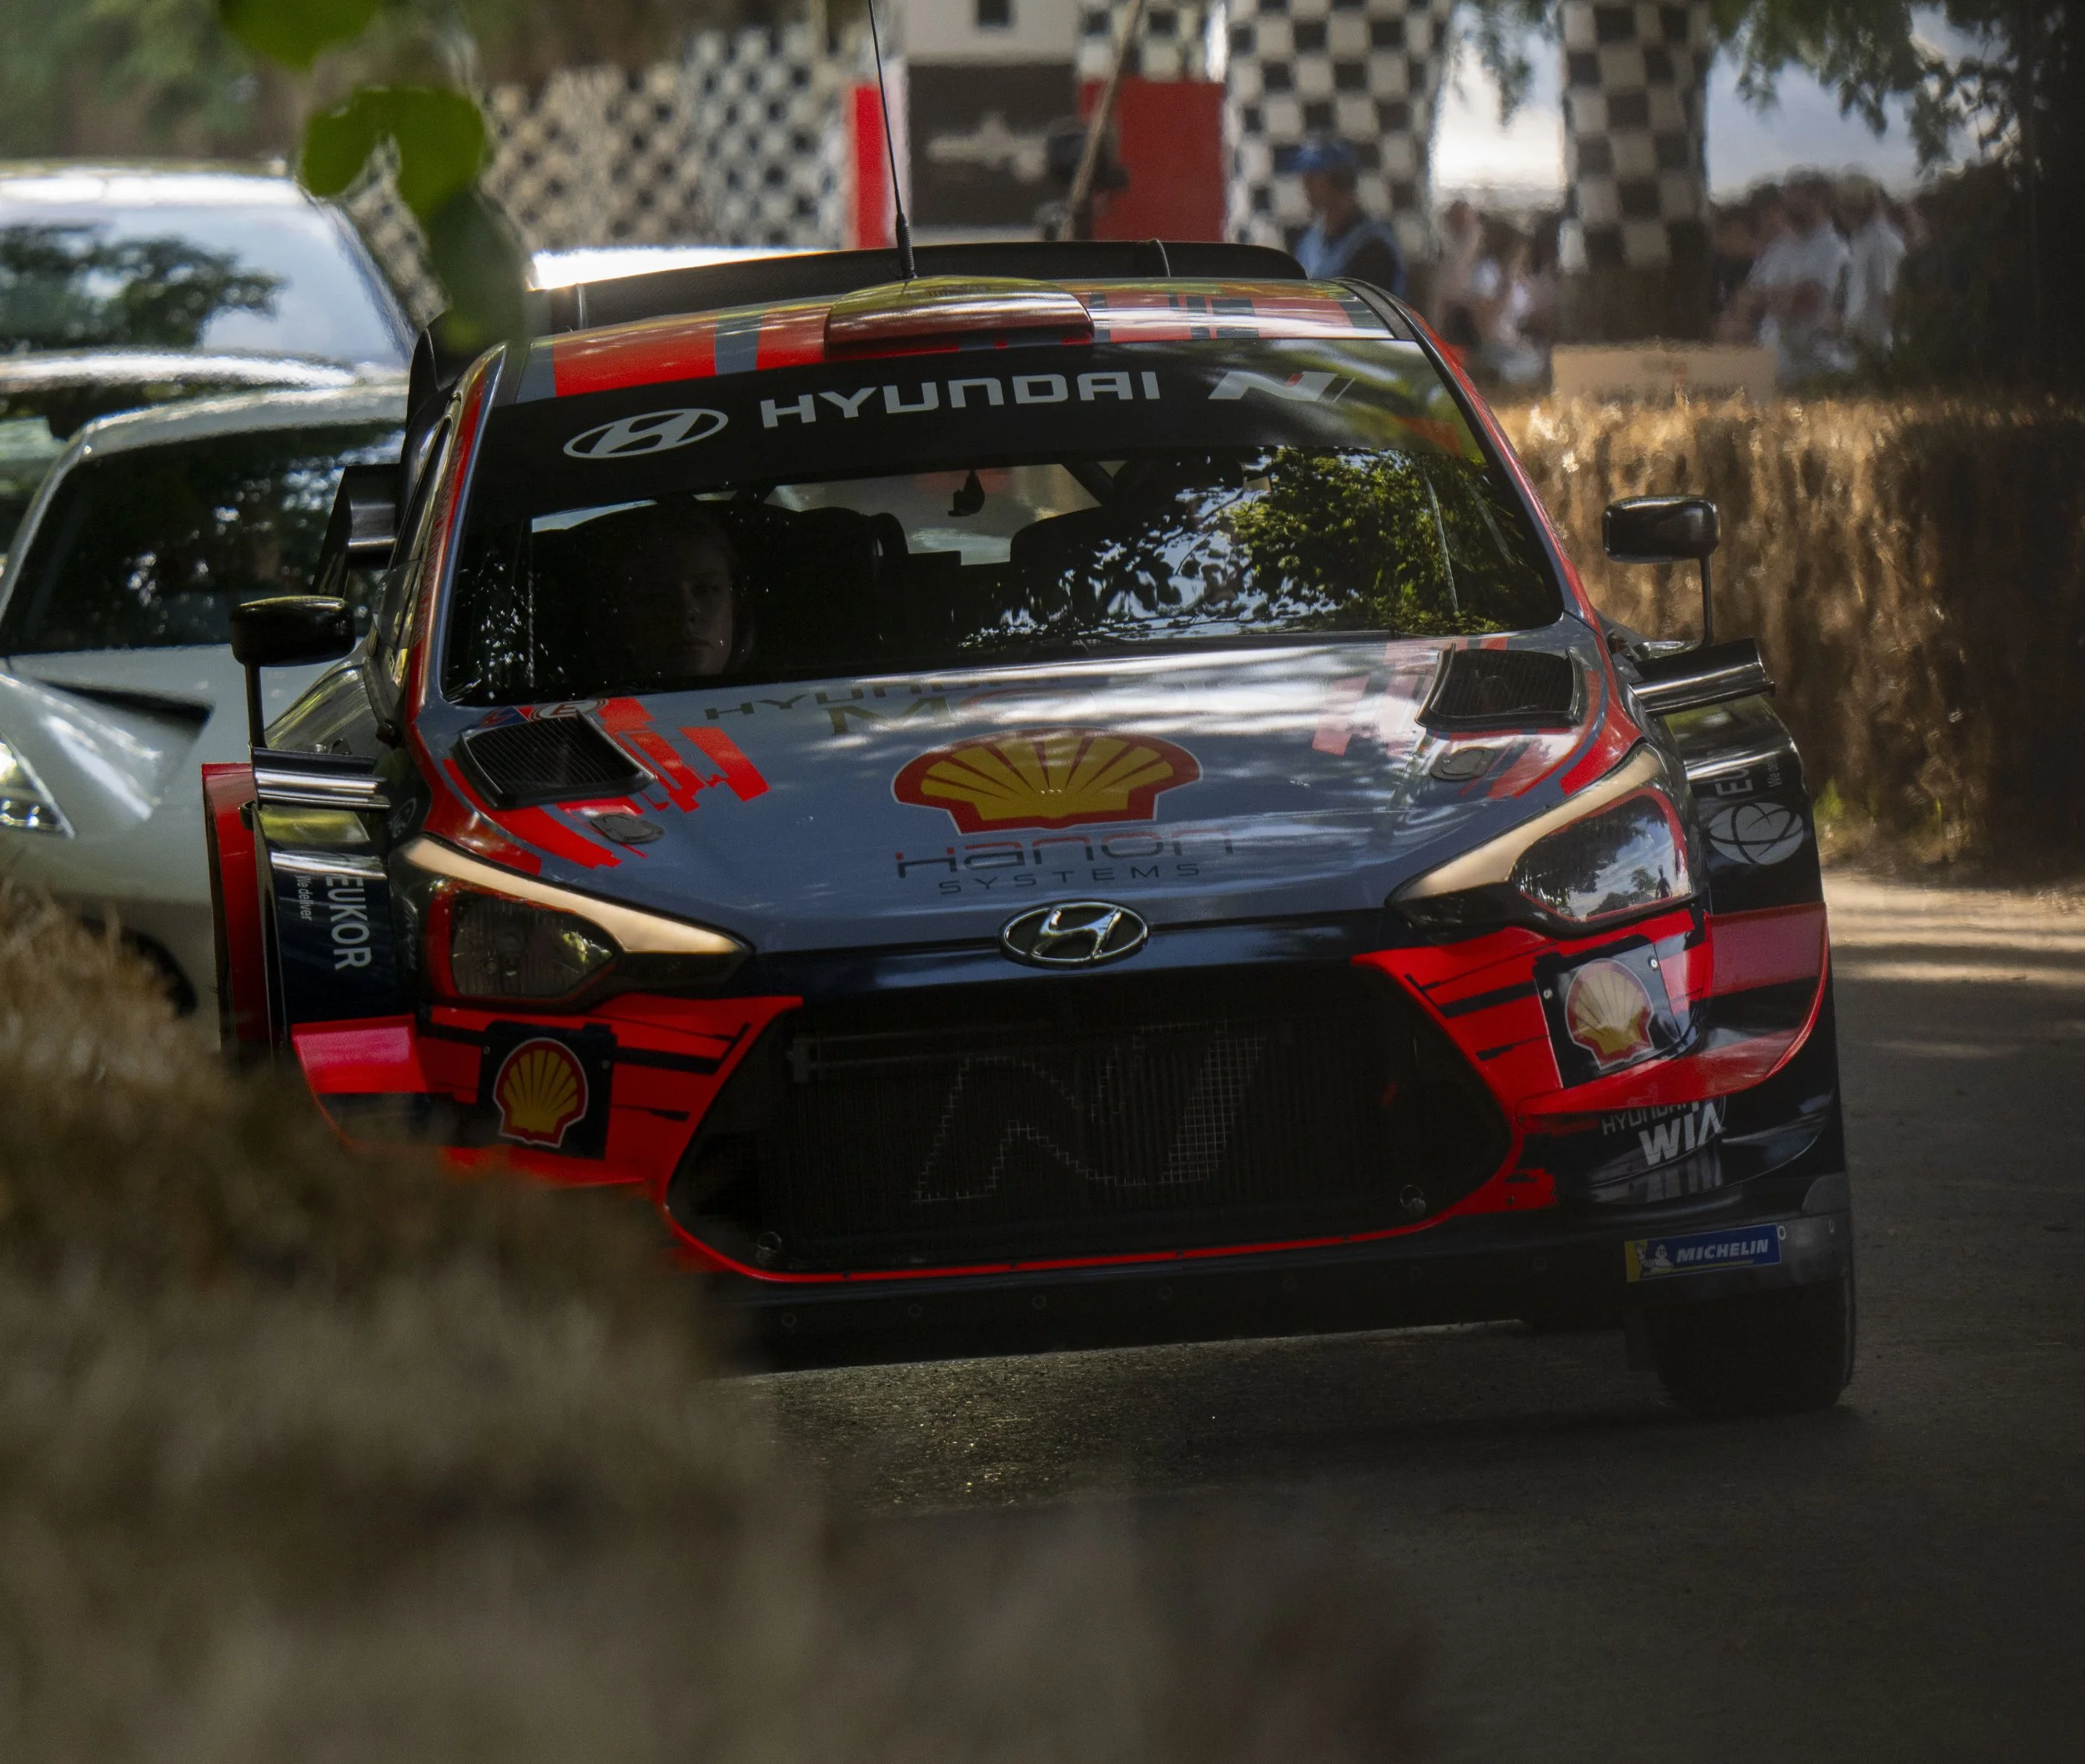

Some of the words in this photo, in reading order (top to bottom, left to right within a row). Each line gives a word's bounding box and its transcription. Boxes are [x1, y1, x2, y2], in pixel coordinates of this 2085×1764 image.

[760, 371, 1160, 429] HYUNDAI
[938, 863, 1201, 895] SYSTEMS
[299, 887, 315, 922] deliver
[325, 876, 372, 971] EUKOR
[1676, 1239, 1769, 1264] MICHELIN
